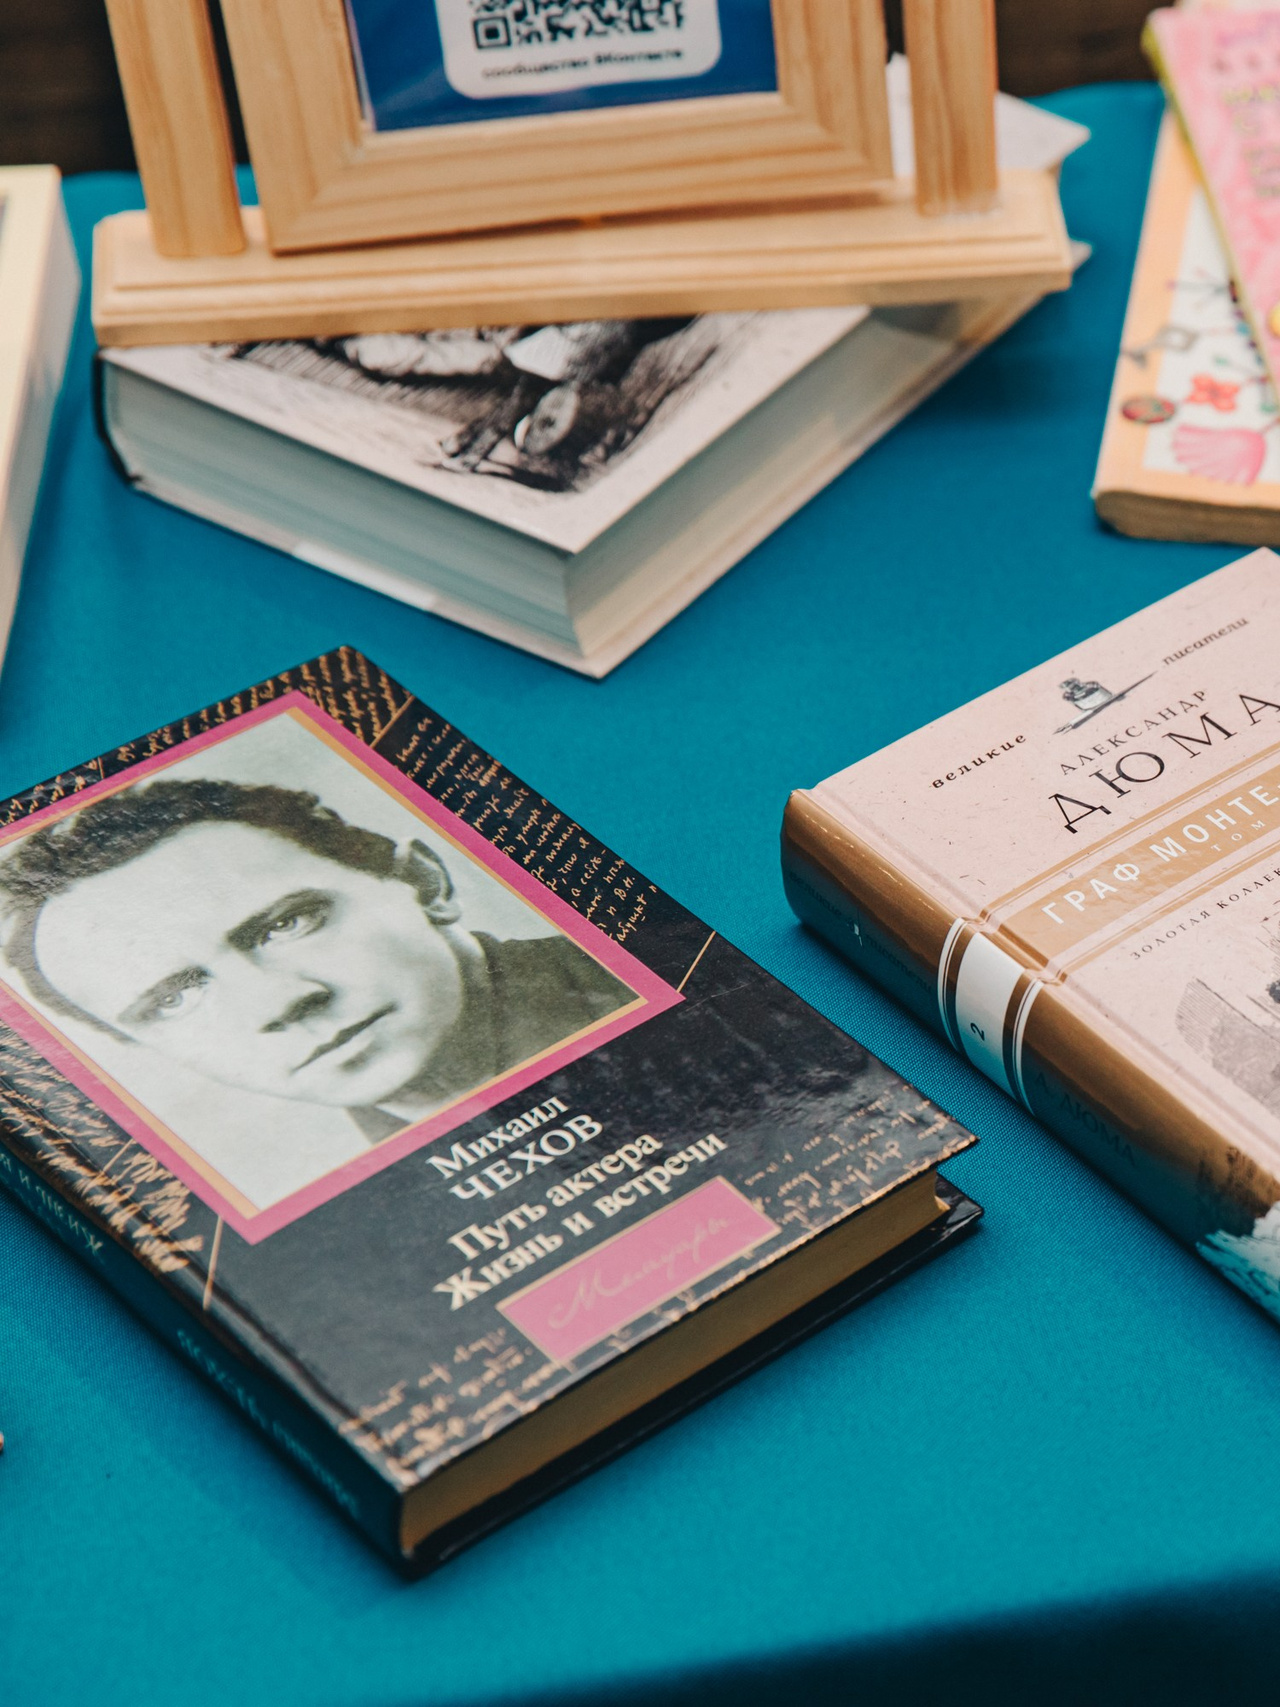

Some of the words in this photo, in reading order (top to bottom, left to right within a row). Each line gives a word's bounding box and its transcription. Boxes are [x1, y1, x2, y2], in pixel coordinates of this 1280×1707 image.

[930, 733, 1028, 790] великие
[1161, 616, 1250, 667] писатели
[1058, 689, 1209, 777] АЛЕКСАНДР
[1210, 819, 1266, 853] ТОМ
[1040, 861, 1141, 926] ГРАФ
[1130, 908, 1212, 960] ЗОЛОТАЯ
[970, 1021, 986, 1042] 2
[425, 1096, 570, 1180] Михаил
[449, 1113, 604, 1201] ЧЕХОВ
[432, 1232, 564, 1311] Жизнь
[561, 1211, 596, 1237] и
[592, 1133, 728, 1219] встречи
[447, 1202, 548, 1261] Путь
[545, 1134, 663, 1207] актера
